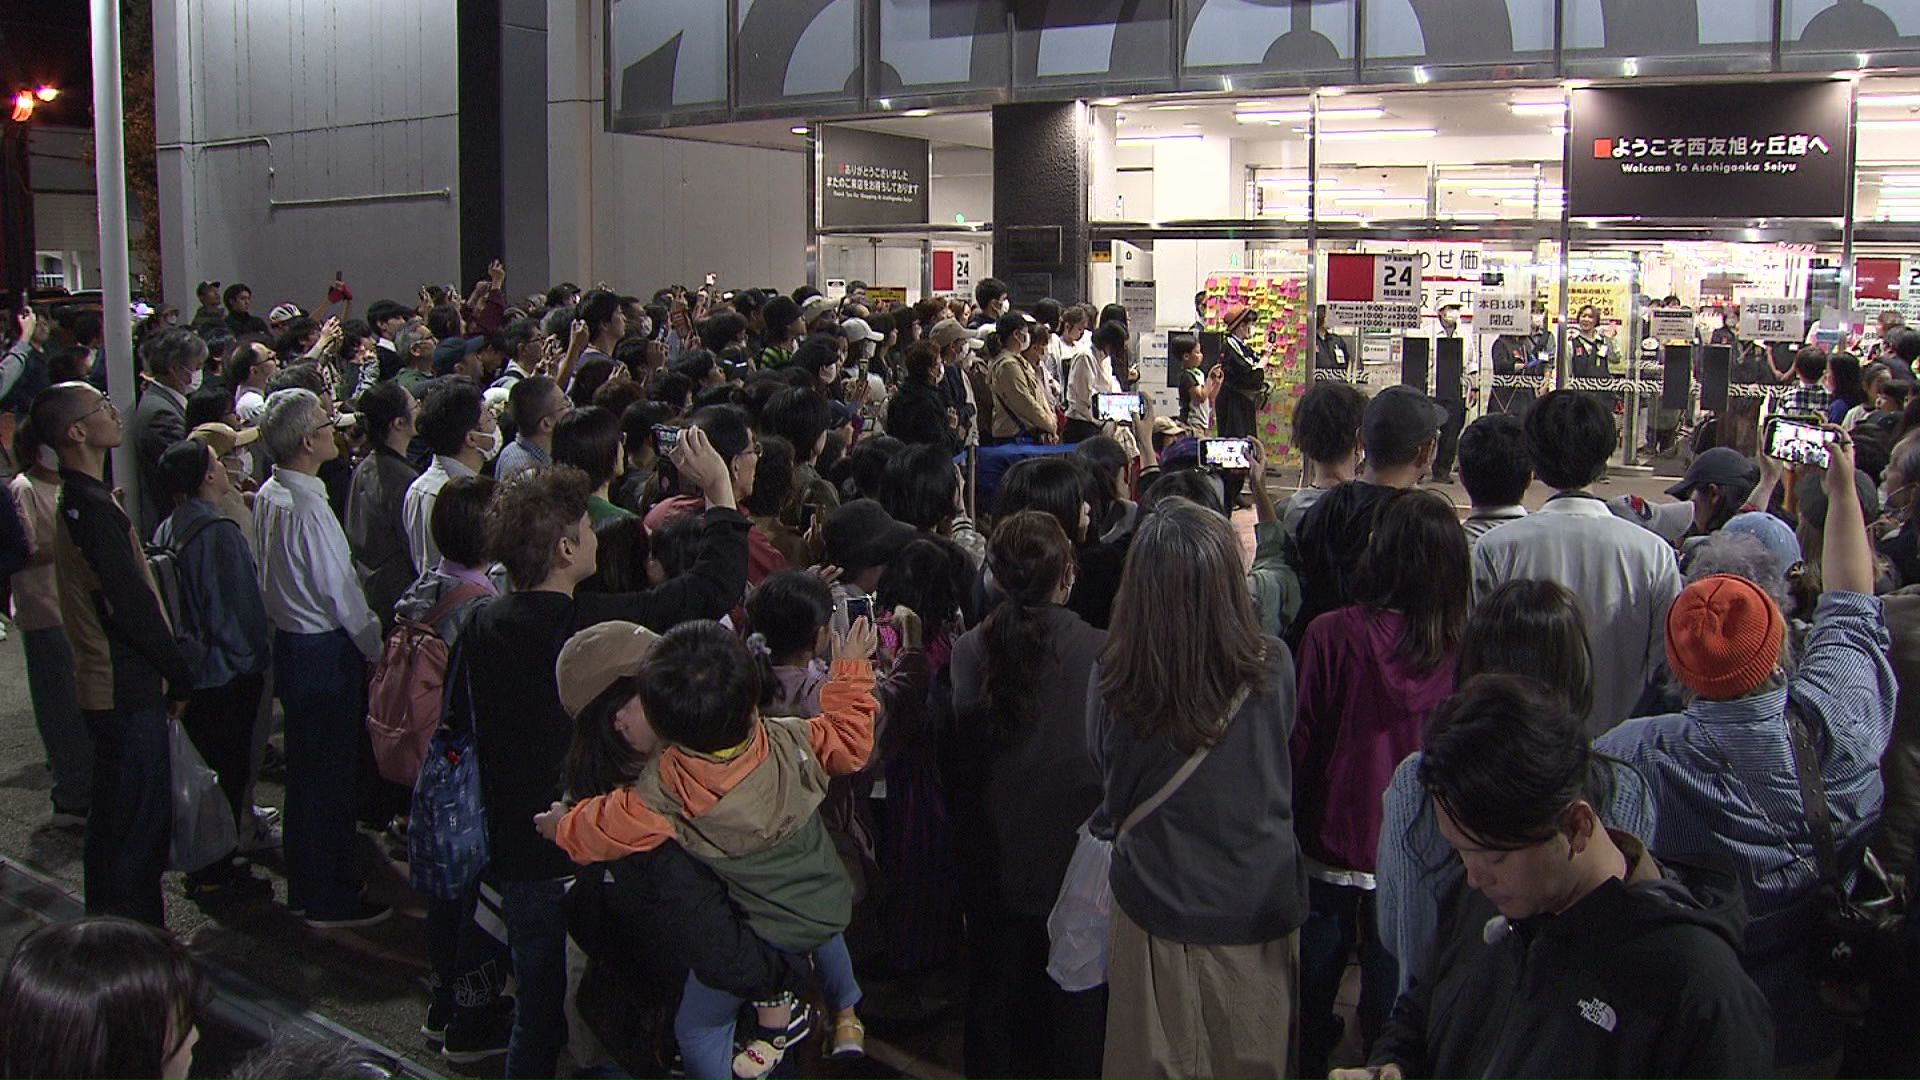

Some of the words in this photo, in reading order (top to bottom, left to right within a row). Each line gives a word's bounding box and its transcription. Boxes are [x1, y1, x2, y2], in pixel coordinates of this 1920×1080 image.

[1612, 135, 1829, 157] ようこそ西友旭ヶ丘店へ
[1621, 162, 1671, 173] Welcome
[1675, 162, 1687, 173] To
[1691, 162, 1760, 174] Asahigaoka
[1764, 161, 1797, 174] Seiyu
[957, 260, 969, 277] 24
[1384, 265, 1412, 286] 24
